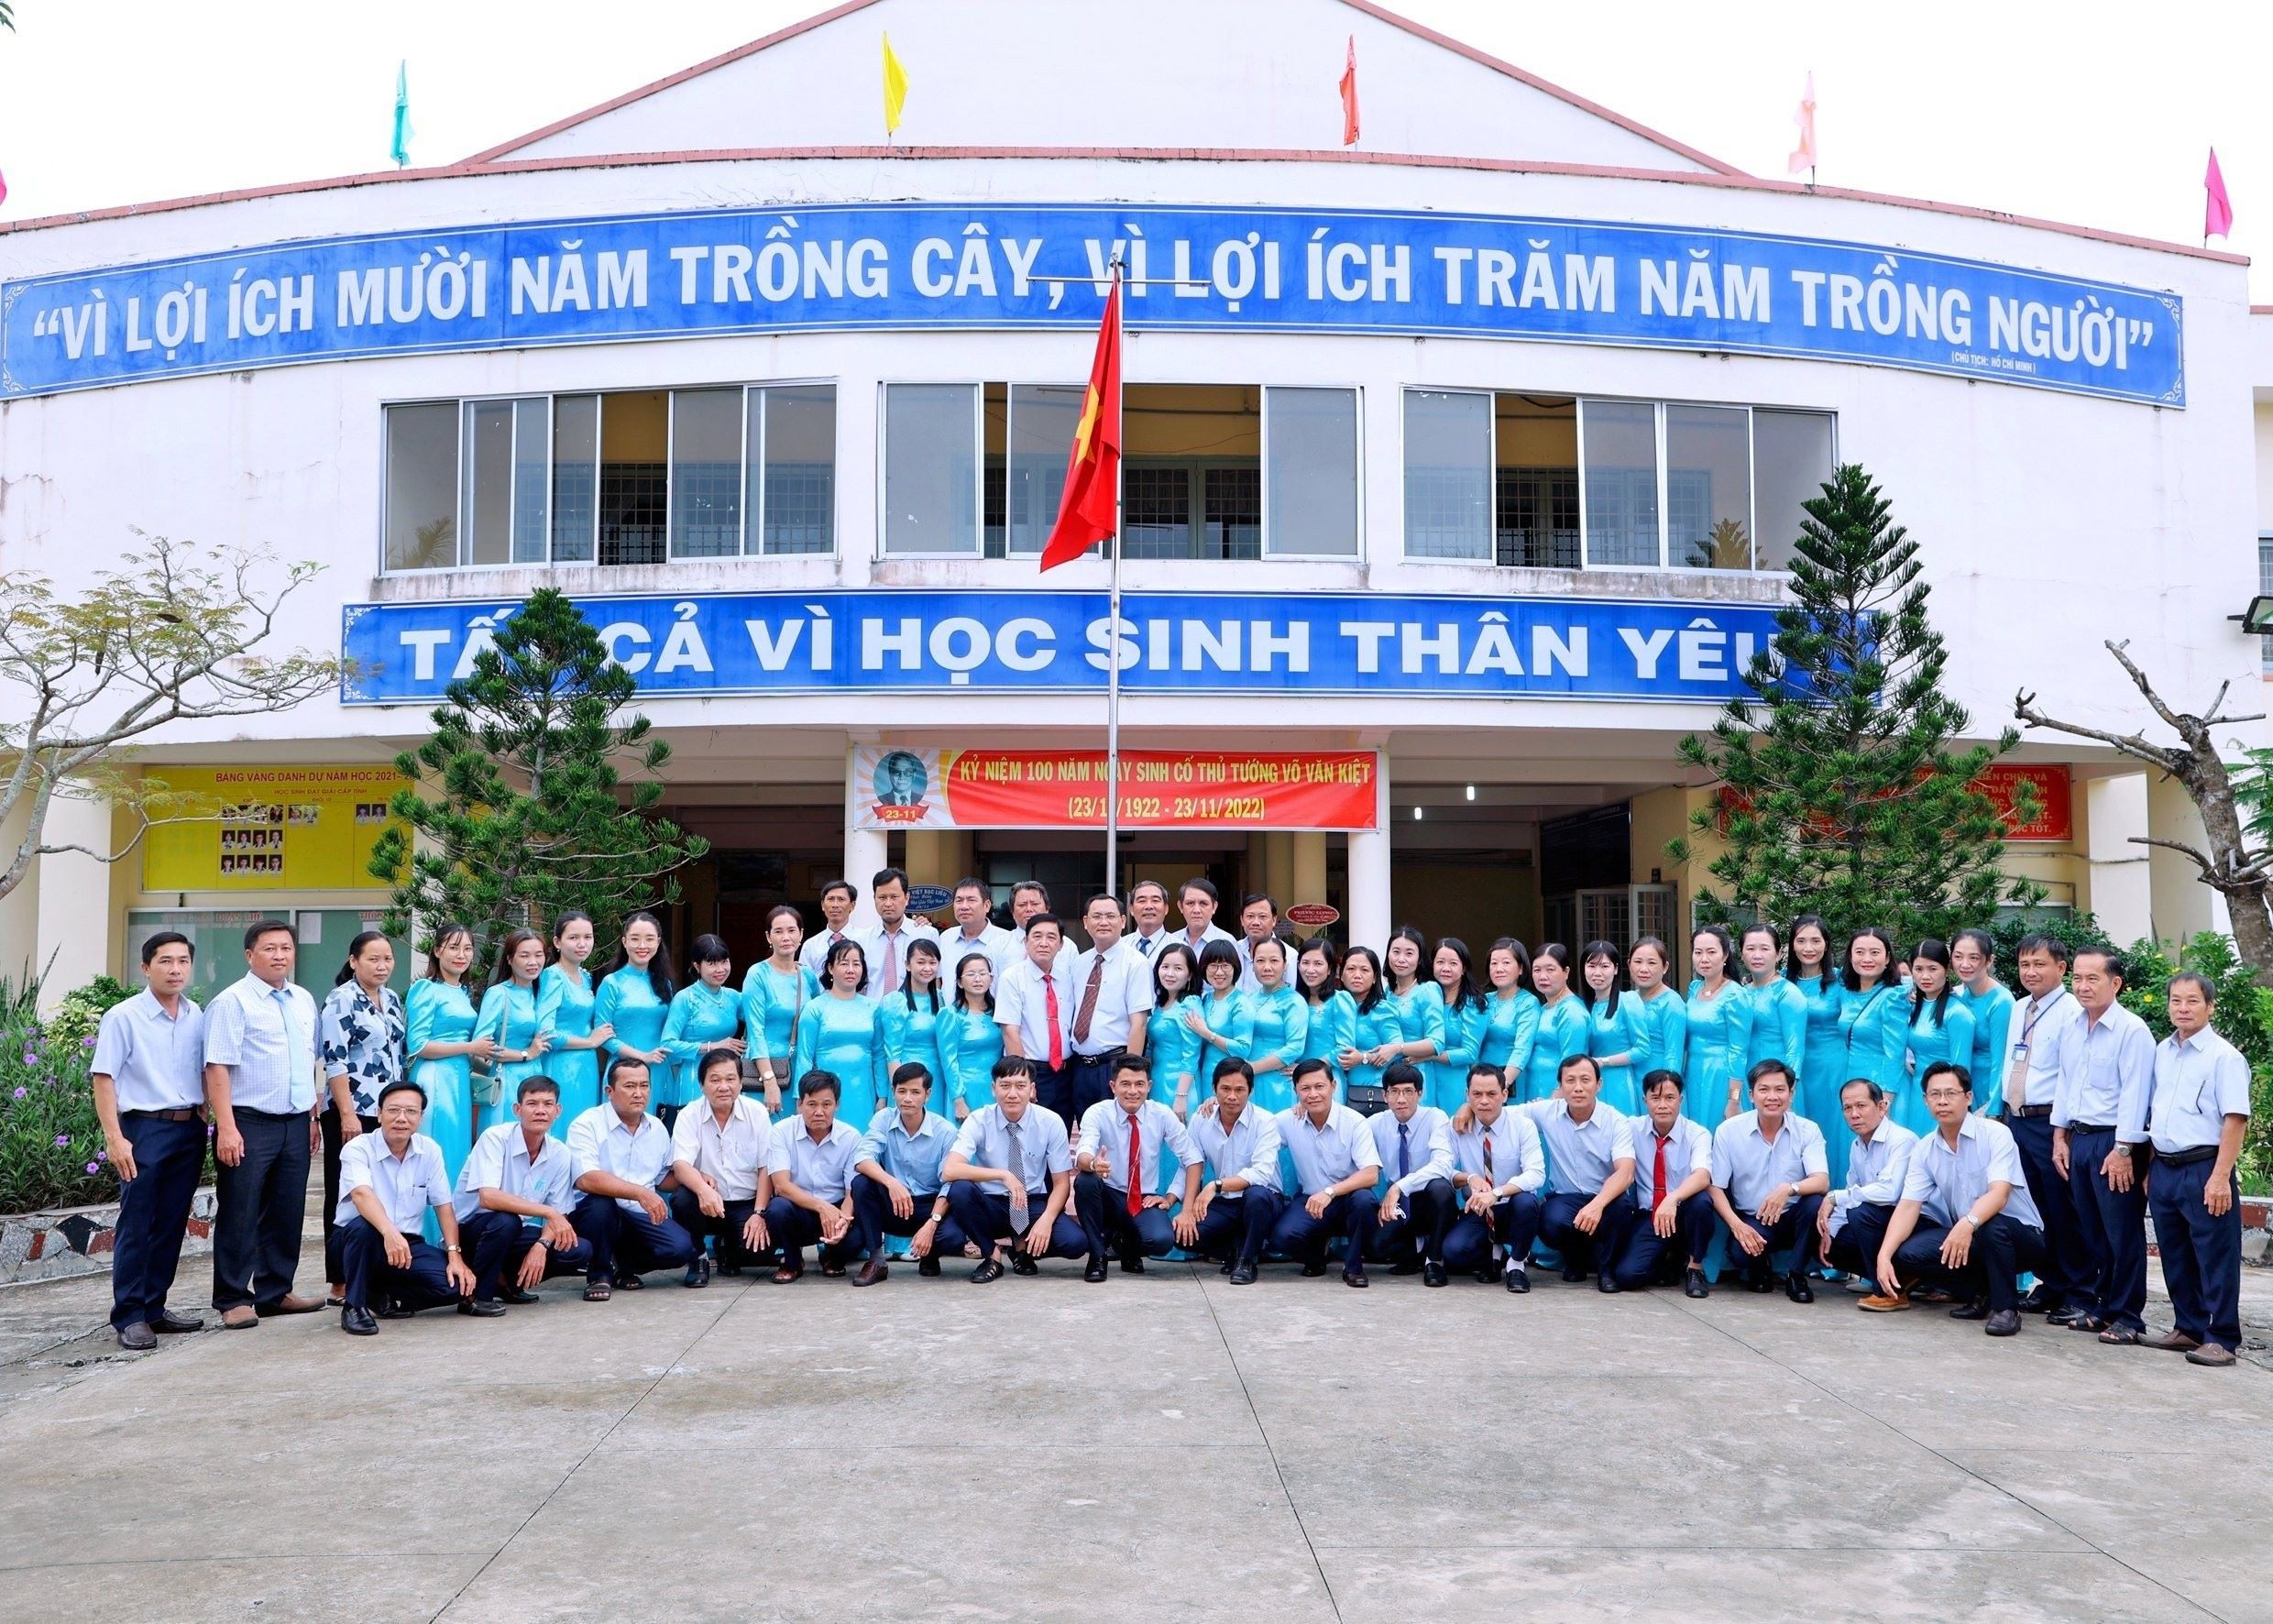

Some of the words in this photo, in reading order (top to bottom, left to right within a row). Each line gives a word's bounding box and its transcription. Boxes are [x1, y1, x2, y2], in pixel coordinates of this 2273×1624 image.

[126, 280, 207, 361] LỢI
[228, 268, 313, 339] ÍCH
[337, 246, 487, 327] MƯỜI
[511, 239, 647, 314] NĂM
[670, 215, 888, 304] TRỒNG
[912, 223, 1064, 310] CÂY,
[1085, 224, 1147, 297] VÌ
[1174, 232, 1279, 313] LỢI
[1307, 228, 1411, 302] ÍCH
[1434, 238, 1615, 313] TRĂM
[1640, 248, 1770, 323] NĂM
[1792, 255, 1971, 346] TRỒNG
[1951, 350, 1970, 364] (CHỦ
[1970, 354, 1989, 368] TỊCH:
[400, 608, 543, 680] TẤ
[596, 602, 714, 675] CẢ
[745, 605, 832, 670] VÌ
[862, 617, 1056, 685] HỌC
[1085, 617, 1309, 672] SINH
[1340, 611, 1587, 676] THÂN
[1617, 618, 1787, 683] YÊU
[278, 772, 306, 782] DANH
[351, 771, 373, 783] HỌC
[961, 753, 981, 782] KỶ
[985, 756, 1022, 785] NIỆM
[1027, 761, 1053, 782] 100
[1058, 757, 1090, 782] NĂM
[1136, 762, 1169, 783] SINH
[1174, 755, 1194, 783] CỐ
[1197, 755, 1225, 783] THỦ
[1230, 758, 1279, 784] TƯỚNG
[1281, 759, 1301, 784] VÕ
[1305, 759, 1334, 784] VĂN
[1338, 758, 1371, 788] KIỆT
[885, 809, 916, 819] 23-11
[1068, 796, 1160, 819] (23/1/1922
